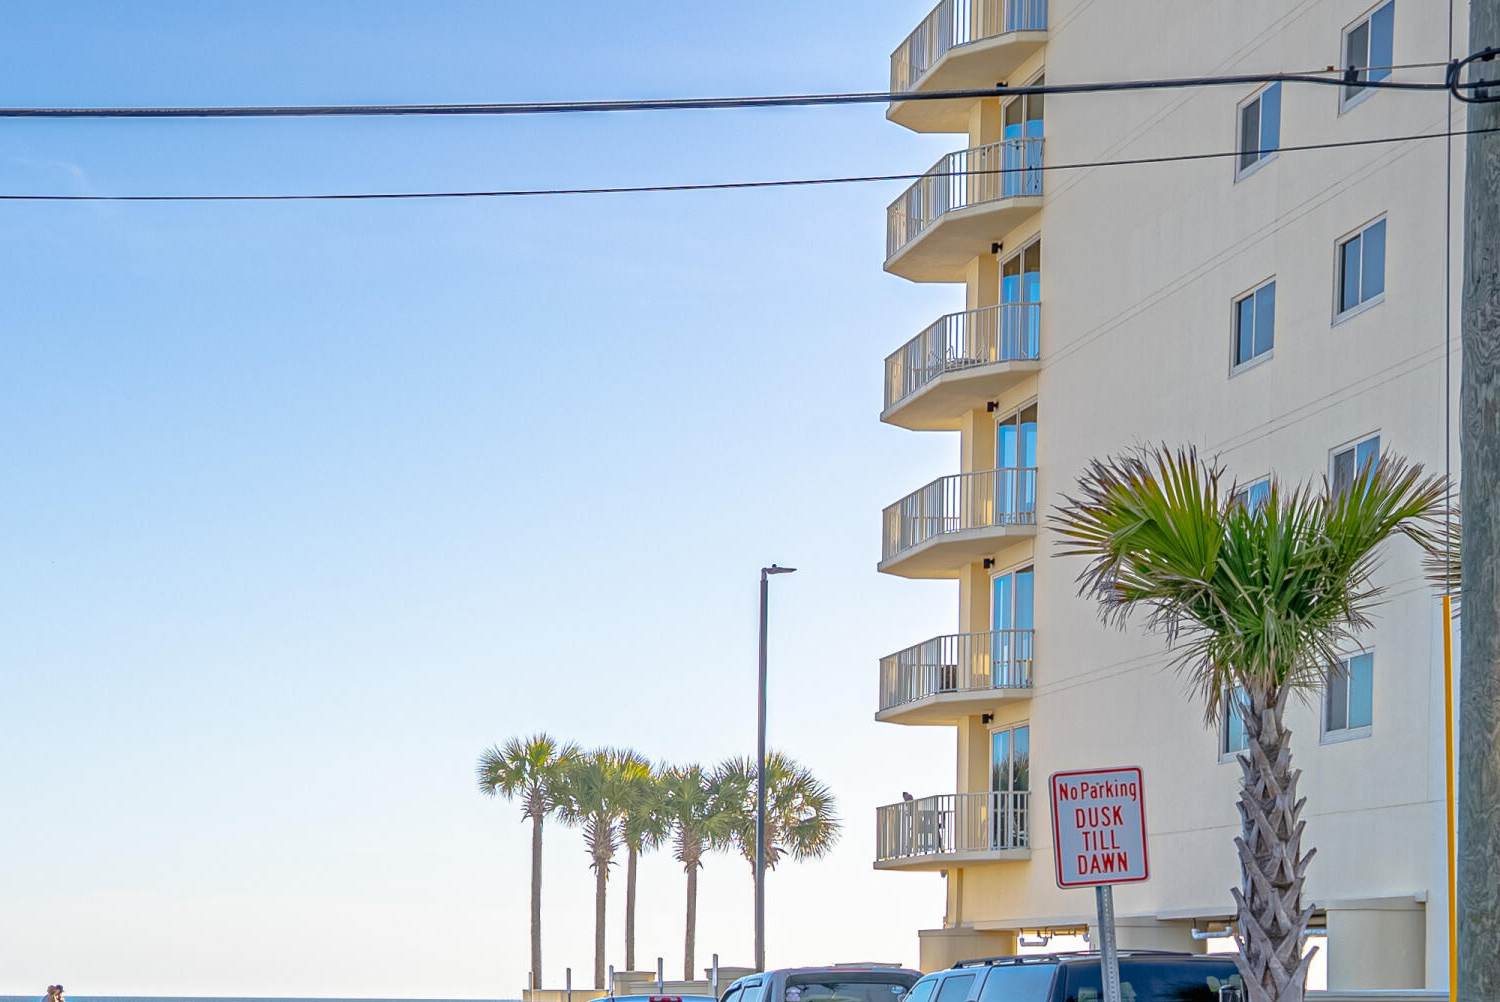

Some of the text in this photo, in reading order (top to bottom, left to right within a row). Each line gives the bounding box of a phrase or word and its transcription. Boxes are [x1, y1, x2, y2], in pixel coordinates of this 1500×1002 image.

[1059, 780, 1137, 802] No Parking
[1075, 804, 1124, 829] DUSK
[1082, 829, 1120, 851] TILL
[1077, 851, 1128, 875] DAWN
